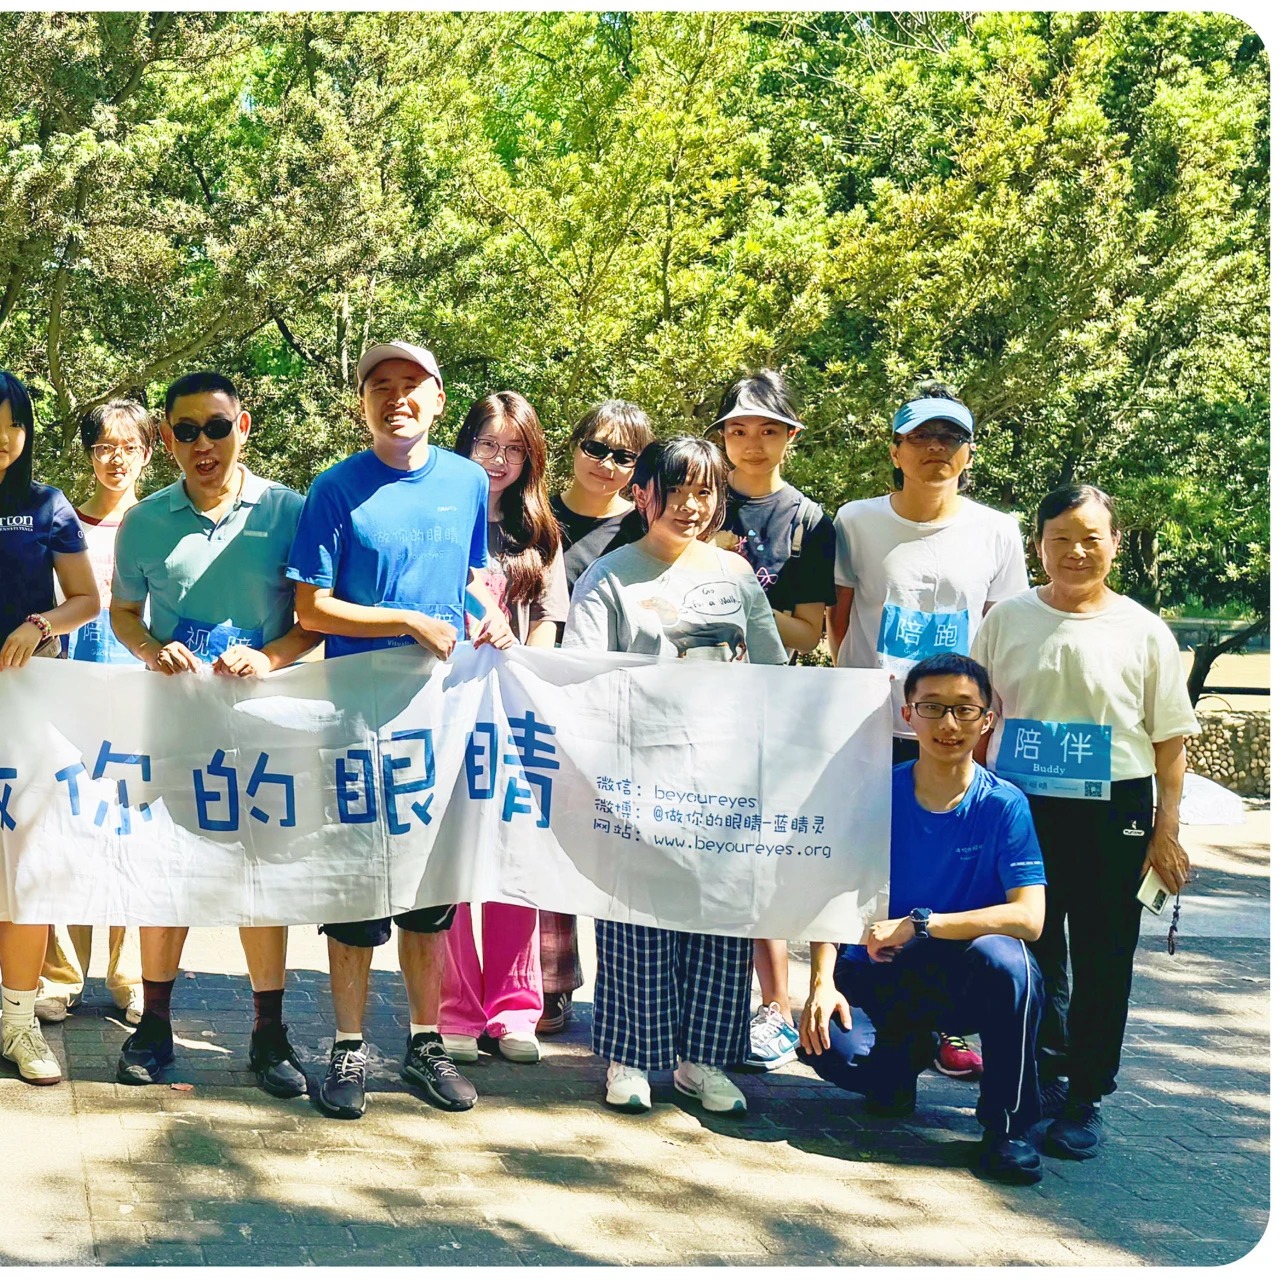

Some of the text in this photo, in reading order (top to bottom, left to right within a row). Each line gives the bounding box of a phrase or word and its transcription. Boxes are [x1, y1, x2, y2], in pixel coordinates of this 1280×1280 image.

[895, 618, 958, 648] 陪跑
[1014, 727, 1094, 764] 陪伴
[1033, 762, 1066, 776] Buddy
[654, 785, 757, 809] beyoureyes
[653, 834, 832, 859] www.beyoureyes.org
